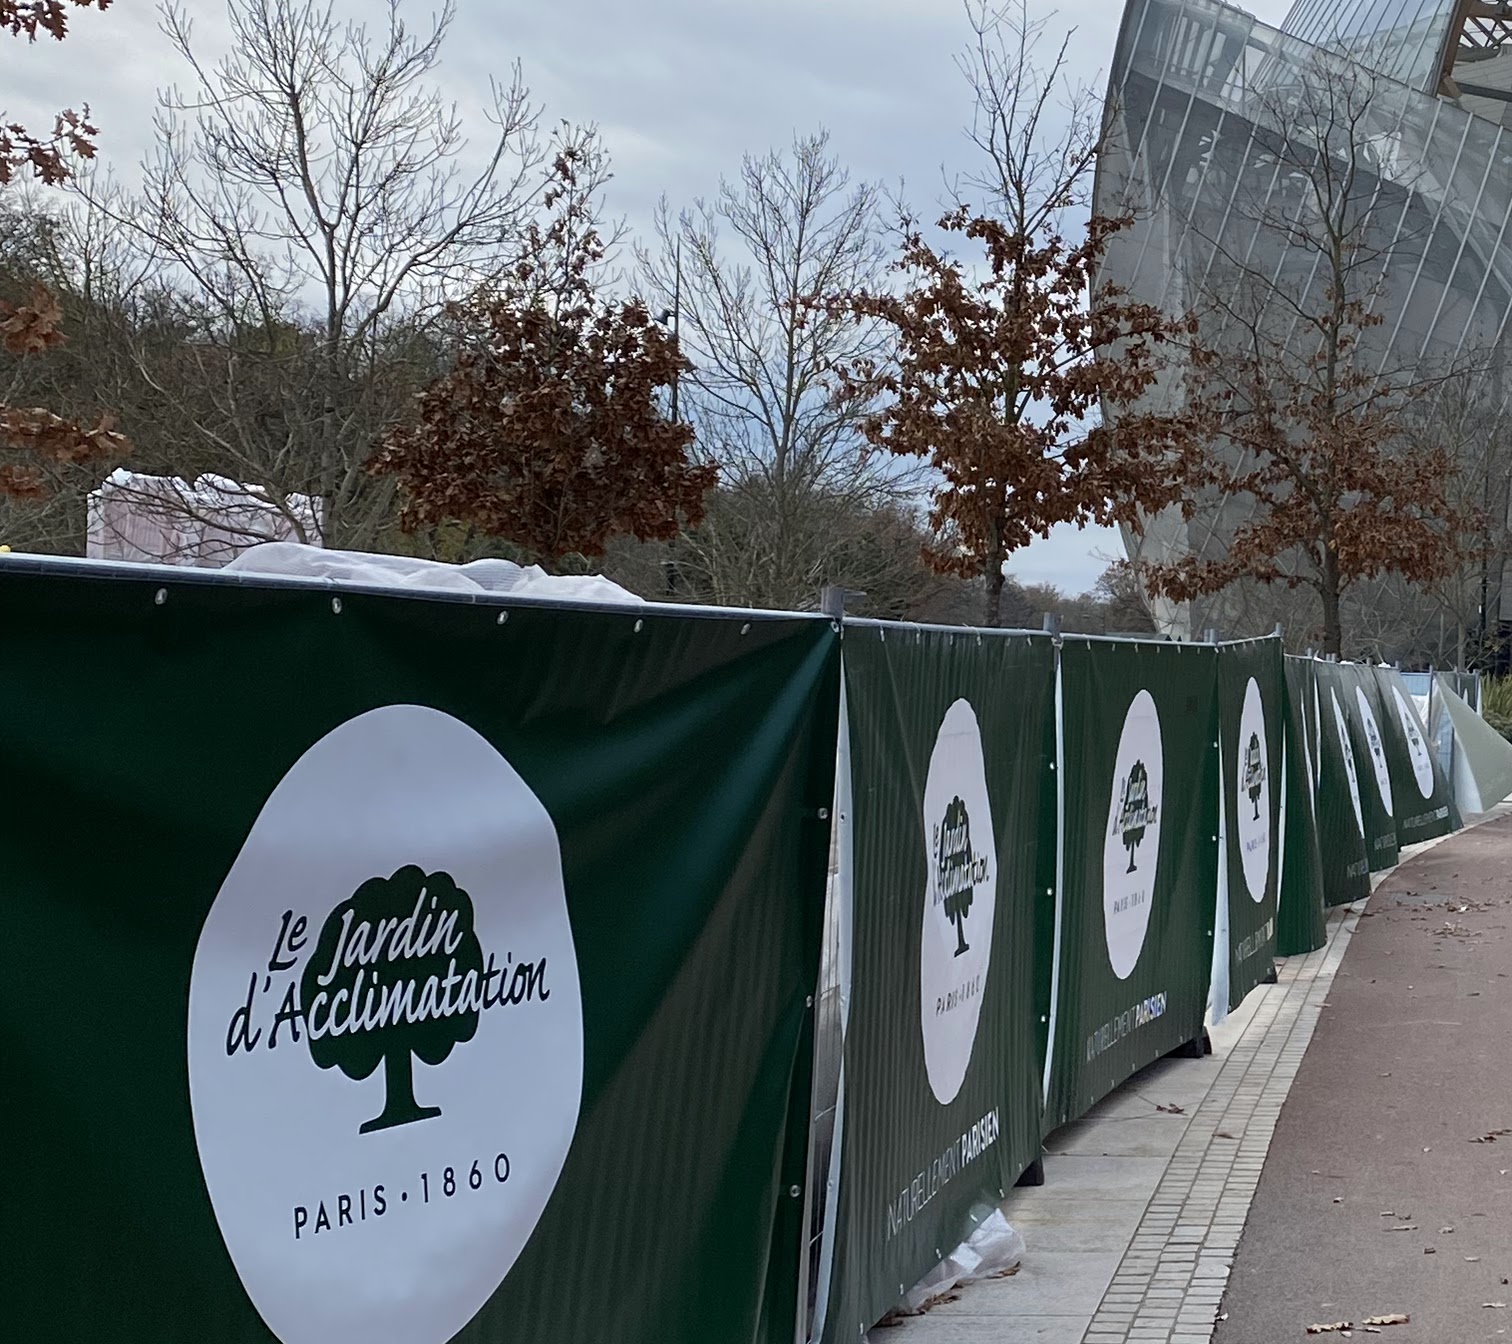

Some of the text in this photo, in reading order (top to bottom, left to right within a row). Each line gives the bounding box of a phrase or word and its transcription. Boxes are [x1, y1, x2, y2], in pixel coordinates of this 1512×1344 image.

[268, 886, 463, 986] Le Jardin
[226, 951, 551, 1057] d'Acclimatation
[293, 1152, 511, 1240] PARIS 1860
